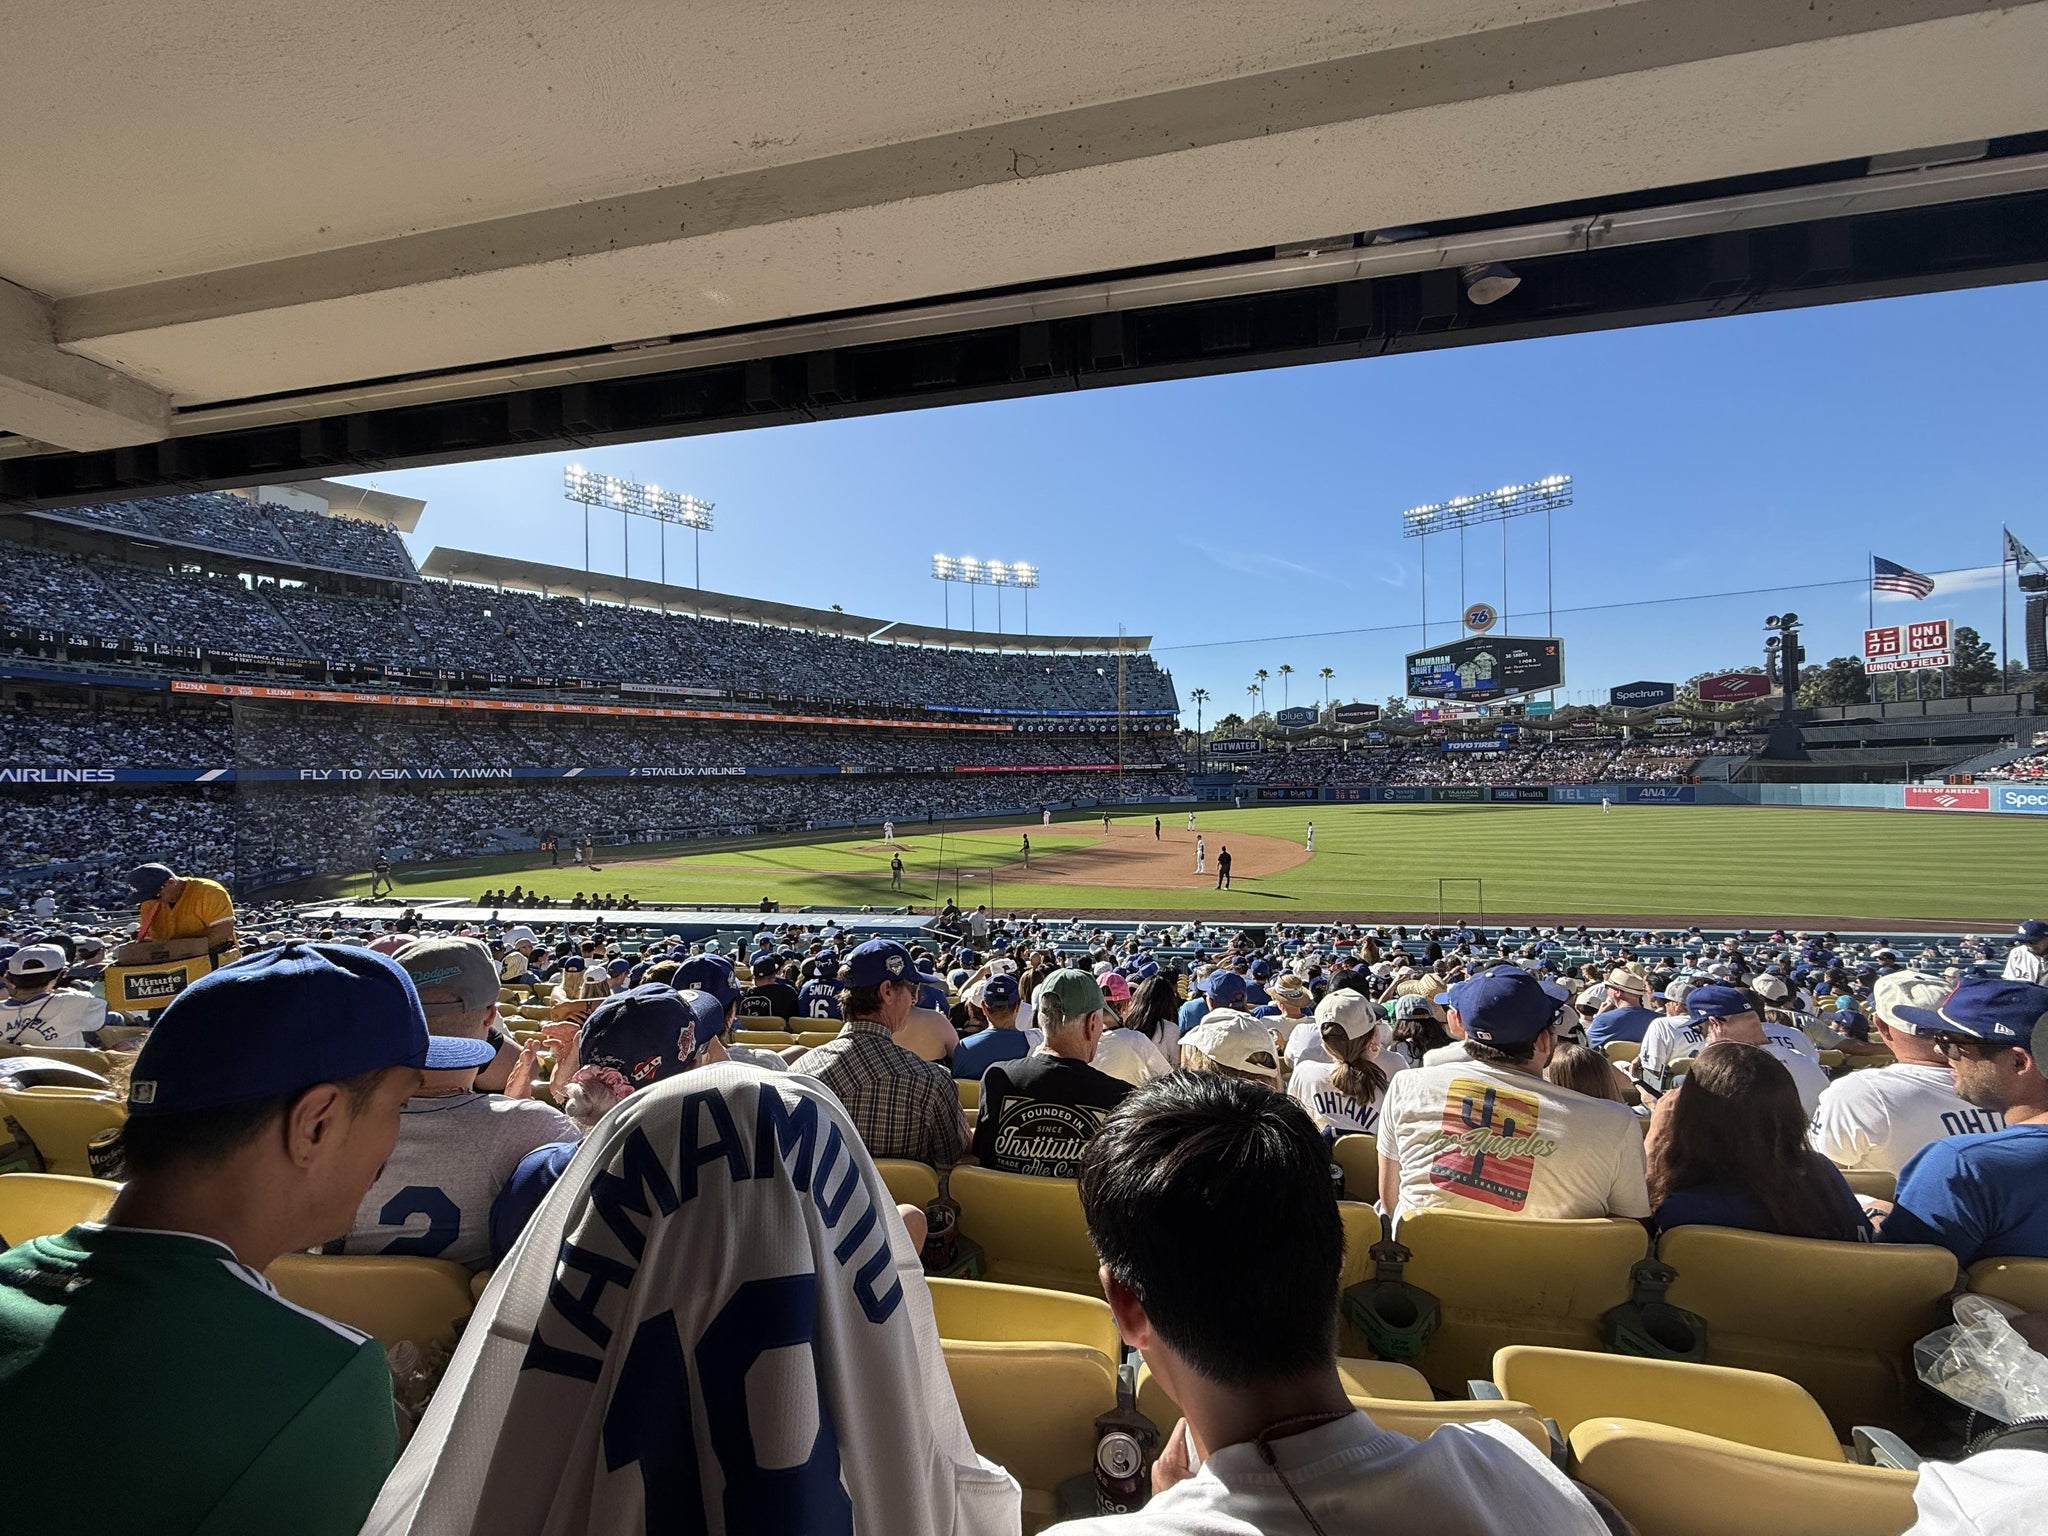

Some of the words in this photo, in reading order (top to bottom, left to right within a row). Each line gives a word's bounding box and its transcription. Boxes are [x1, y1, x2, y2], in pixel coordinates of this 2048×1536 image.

[1470, 609, 1488, 624] 76
[1869, 630, 1895, 642] ユニ
[1912, 625, 1939, 636] UNI
[38, 634, 54, 642] 3-1
[68, 638, 88, 646] 3.38
[1912, 636, 1943, 649] QLO
[1868, 642, 1896, 653] クロ
[1416, 656, 1450, 666] HAWAIIAN
[1870, 660, 1908, 672] UNIQLO
[1912, 657, 1945, 667] FIELD
[1410, 665, 1431, 675] SHIRT
[1434, 663, 1456, 672] NIGHT
[1616, 689, 1664, 700] Spectrum
[1281, 712, 1303, 720] blue
[1212, 742, 1256, 750] CUTWATER
[0, 768, 115, 782] AIRLINES
[300, 770, 332, 780] FLY
[338, 769, 362, 780] TO
[368, 769, 412, 779] ASIA
[416, 769, 445, 779] VIA
[450, 768, 512, 778] TAIWAN
[642, 768, 694, 776] STARLUX
[697, 767, 746, 775] AIRLINES
[1263, 790, 1278, 798] blue
[1290, 790, 1306, 798] blue
[1556, 789, 1584, 799] TEL
[1640, 788, 1666, 797] ANA
[2005, 792, 2048, 807] Spec
[130, 975, 181, 987] Minute
[411, 966, 462, 984] Dodgers
[138, 984, 174, 996] Maid
[810, 985, 835, 996] SMITH
[744, 1000, 760, 1009] SEND
[810, 1000, 829, 1018] 16
[6, 1018, 58, 1041] ANGELES
[1314, 1092, 1379, 1130] OHTANI
[1021, 1108, 1072, 1121] FOUNDED
[1073, 1118, 1084, 1130] IN
[1940, 1108, 2006, 1136] OHT
[995, 1126, 1091, 1160] Instituti
[1458, 1127, 1558, 1160] Angeles
[998, 1159, 1018, 1168] TRADE
[1022, 1158, 1050, 1176] Ale
[1473, 1179, 1522, 1198] TRAINING
[379, 1186, 461, 1256] 2
